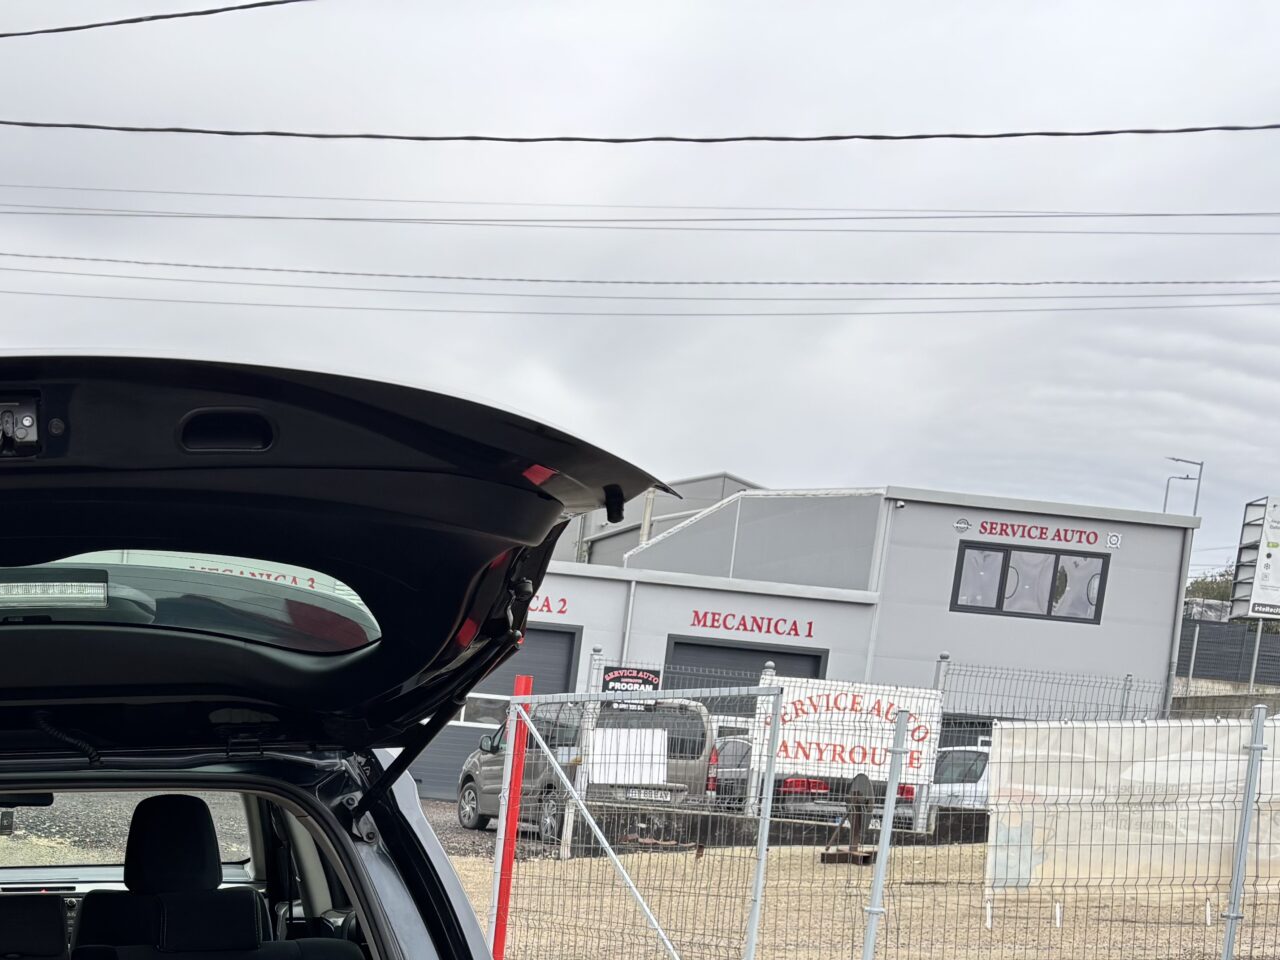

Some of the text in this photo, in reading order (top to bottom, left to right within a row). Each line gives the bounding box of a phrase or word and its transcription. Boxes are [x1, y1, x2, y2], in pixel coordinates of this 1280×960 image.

[979, 520, 1099, 545] SERVICE AUTO
[557, 598, 568, 614] 2
[690, 610, 814, 638] MECANICA 1
[605, 669, 659, 684] SERVICE AUTO
[609, 682, 653, 691] PROGRAM
[777, 739, 923, 769] ANYROUE
